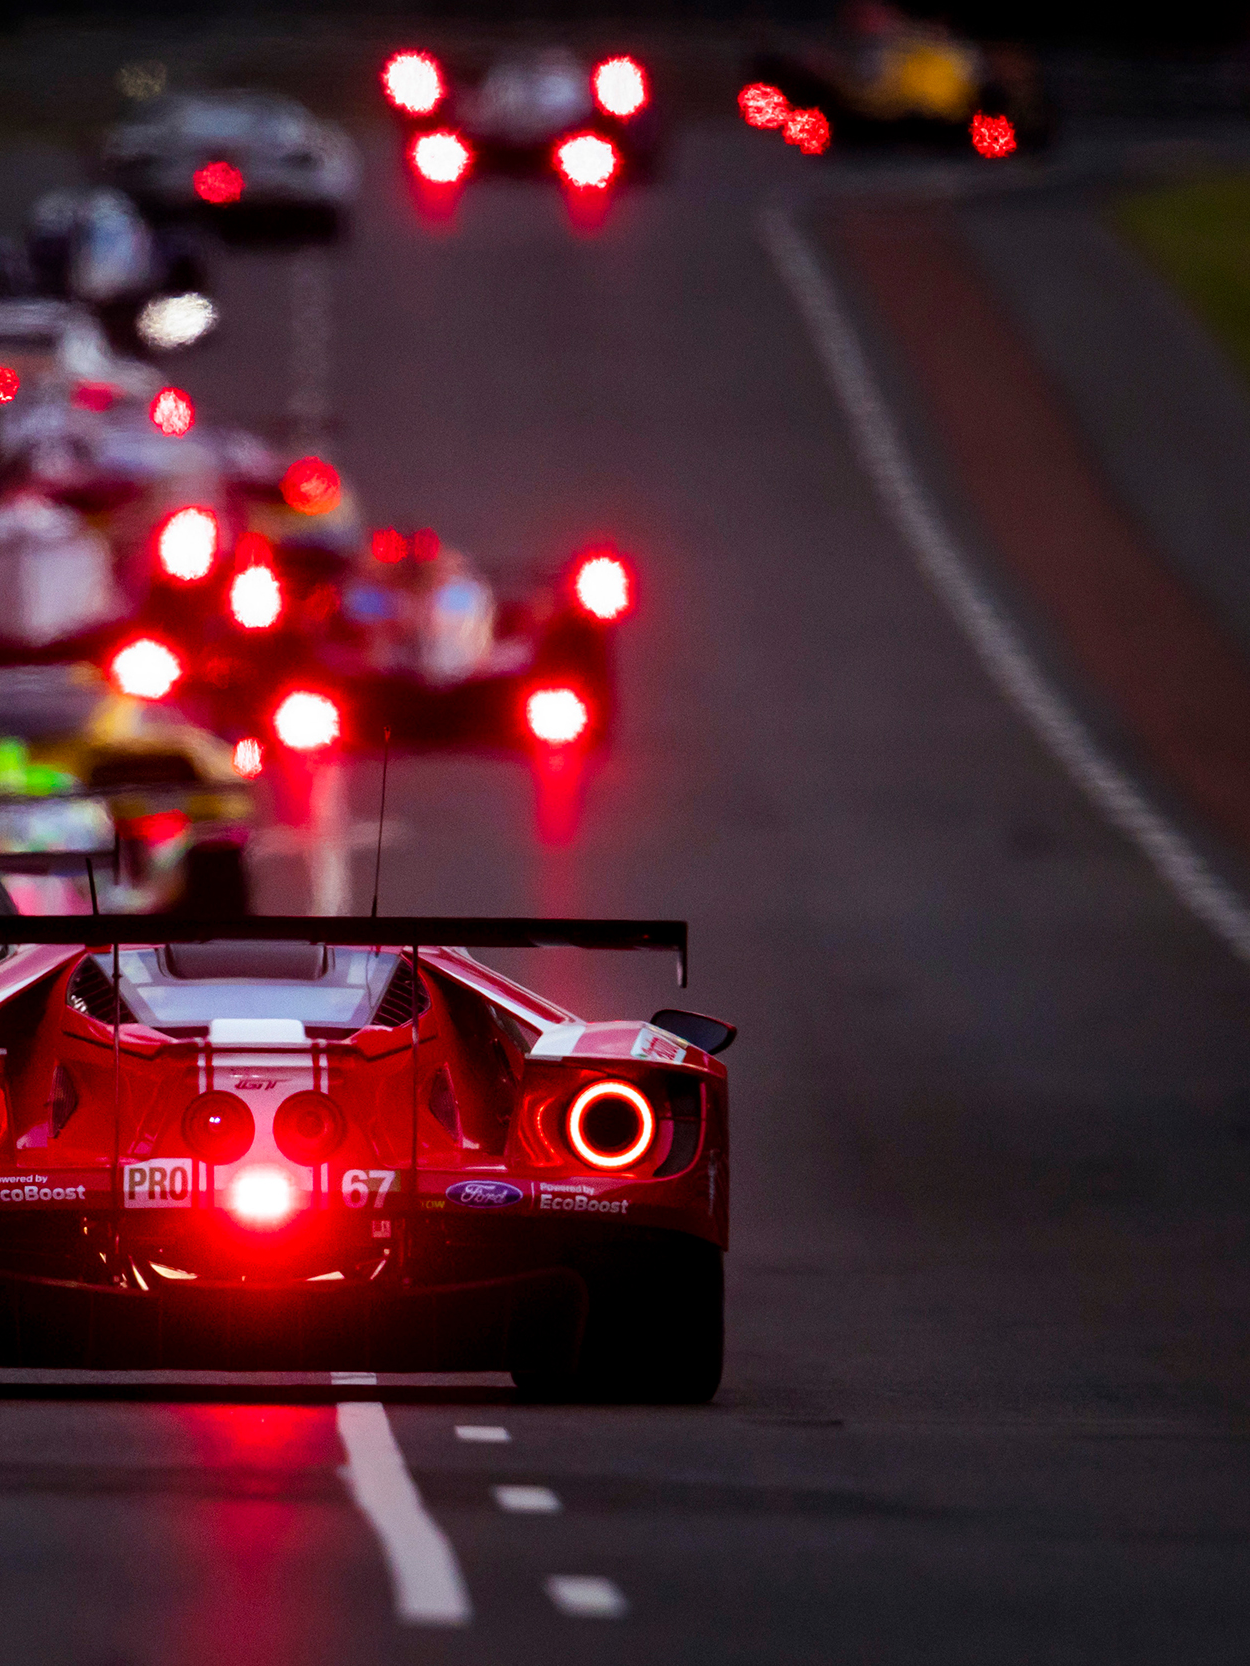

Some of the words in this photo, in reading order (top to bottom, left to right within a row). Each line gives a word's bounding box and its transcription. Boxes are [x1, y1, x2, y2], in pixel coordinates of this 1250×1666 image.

[35, 1174, 48, 1185] by
[129, 1166, 188, 1201] PRO
[342, 1169, 396, 1209] 67
[539, 1182, 582, 1194] Powered
[583, 1185, 595, 1197] by
[461, 1183, 508, 1203] Ford
[540, 1194, 629, 1214] EcoBoost
